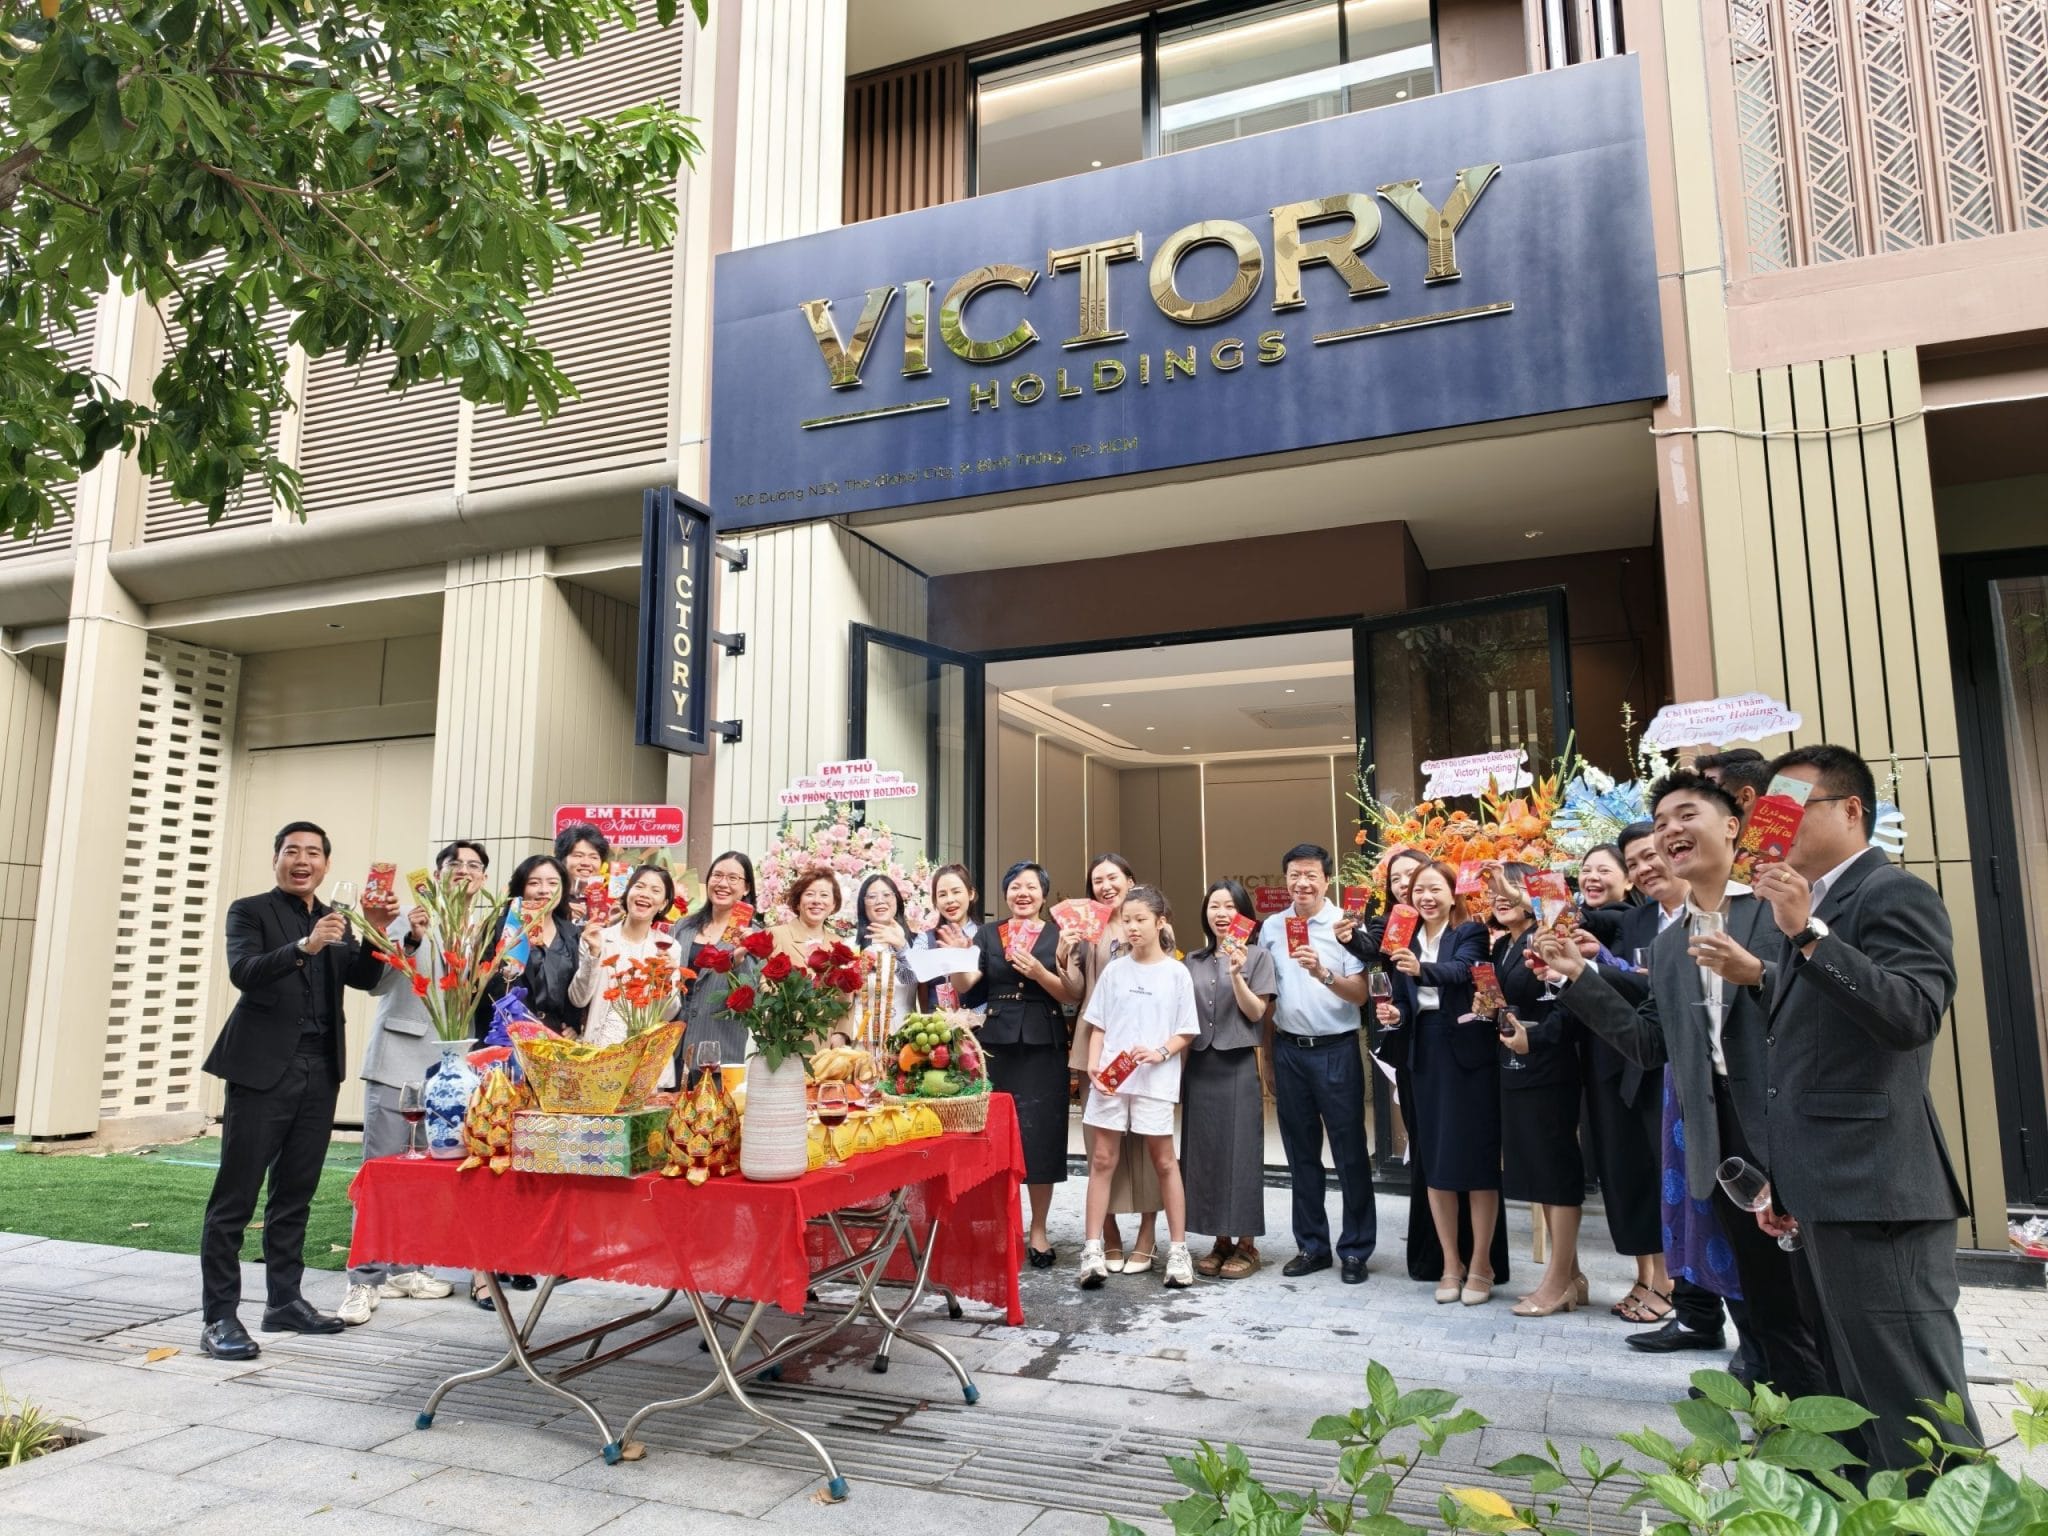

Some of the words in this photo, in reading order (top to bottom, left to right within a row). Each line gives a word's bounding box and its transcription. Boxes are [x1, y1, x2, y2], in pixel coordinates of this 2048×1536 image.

[800, 163, 1502, 388] VICTORY
[969, 329, 1287, 412] HOLDINGS
[845, 477, 870, 491] The
[875, 466, 919, 488] Global
[671, 513, 695, 717] VICTORY
[1689, 714, 1726, 724] Victory
[1729, 706, 1779, 721] Holdings
[823, 765, 841, 775] EM
[1454, 767, 1480, 778] Victory
[1482, 763, 1516, 775] Holdings
[833, 789, 871, 800] VICTORY
[873, 785, 917, 798] HOLDINGS
[585, 808, 614, 819] EM
[621, 808, 657, 819] KIM
[618, 834, 668, 844] HOLDINGS
